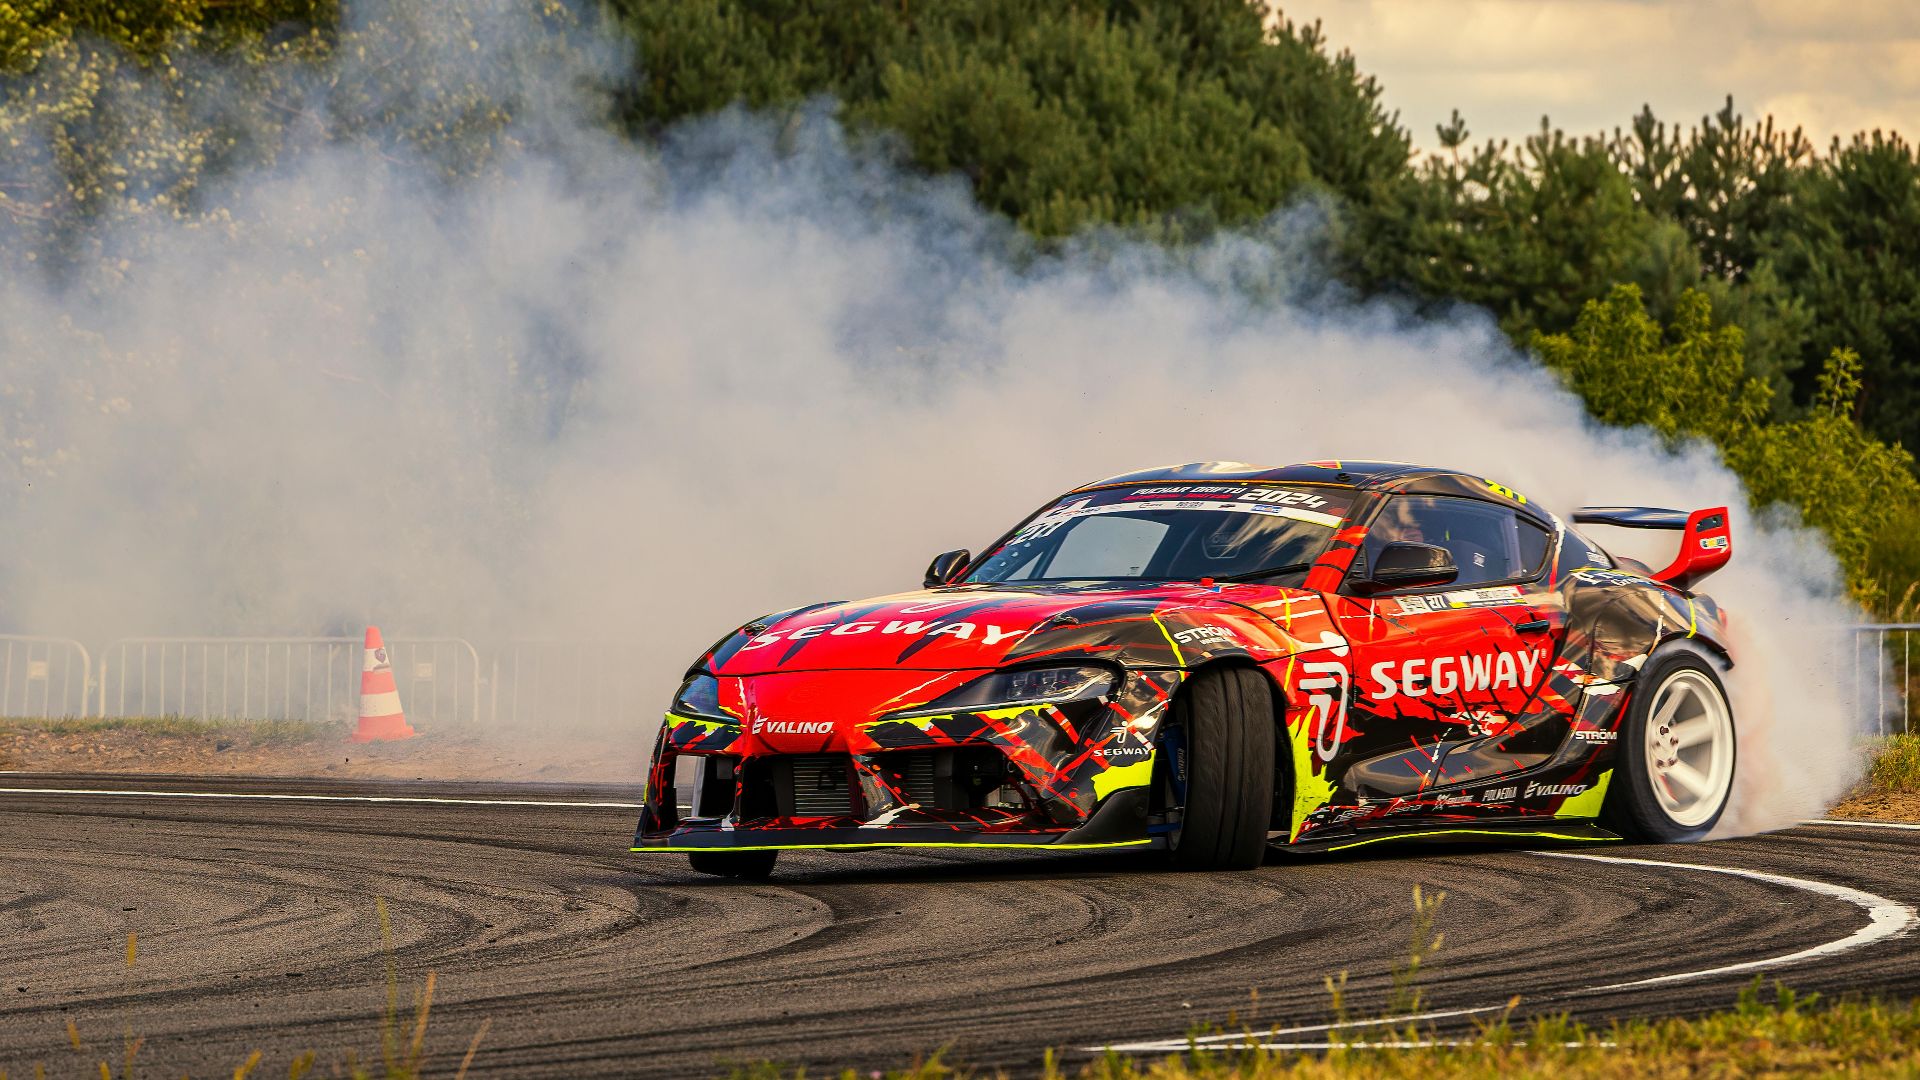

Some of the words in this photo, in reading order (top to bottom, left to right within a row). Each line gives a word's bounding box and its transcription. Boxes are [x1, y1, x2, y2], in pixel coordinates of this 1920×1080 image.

[1130, 486, 1193, 496] PUCHAR
[1237, 488, 1329, 509] 2024
[741, 620, 1029, 652] SEGWAY
[1173, 623, 1238, 644] STRÖM
[1370, 649, 1540, 700] SEGWAY
[767, 721, 835, 734] VALINO
[1575, 728, 1618, 740] STRÖM
[1093, 747, 1150, 757] SEGWAY
[1536, 784, 1589, 796] VALINO
